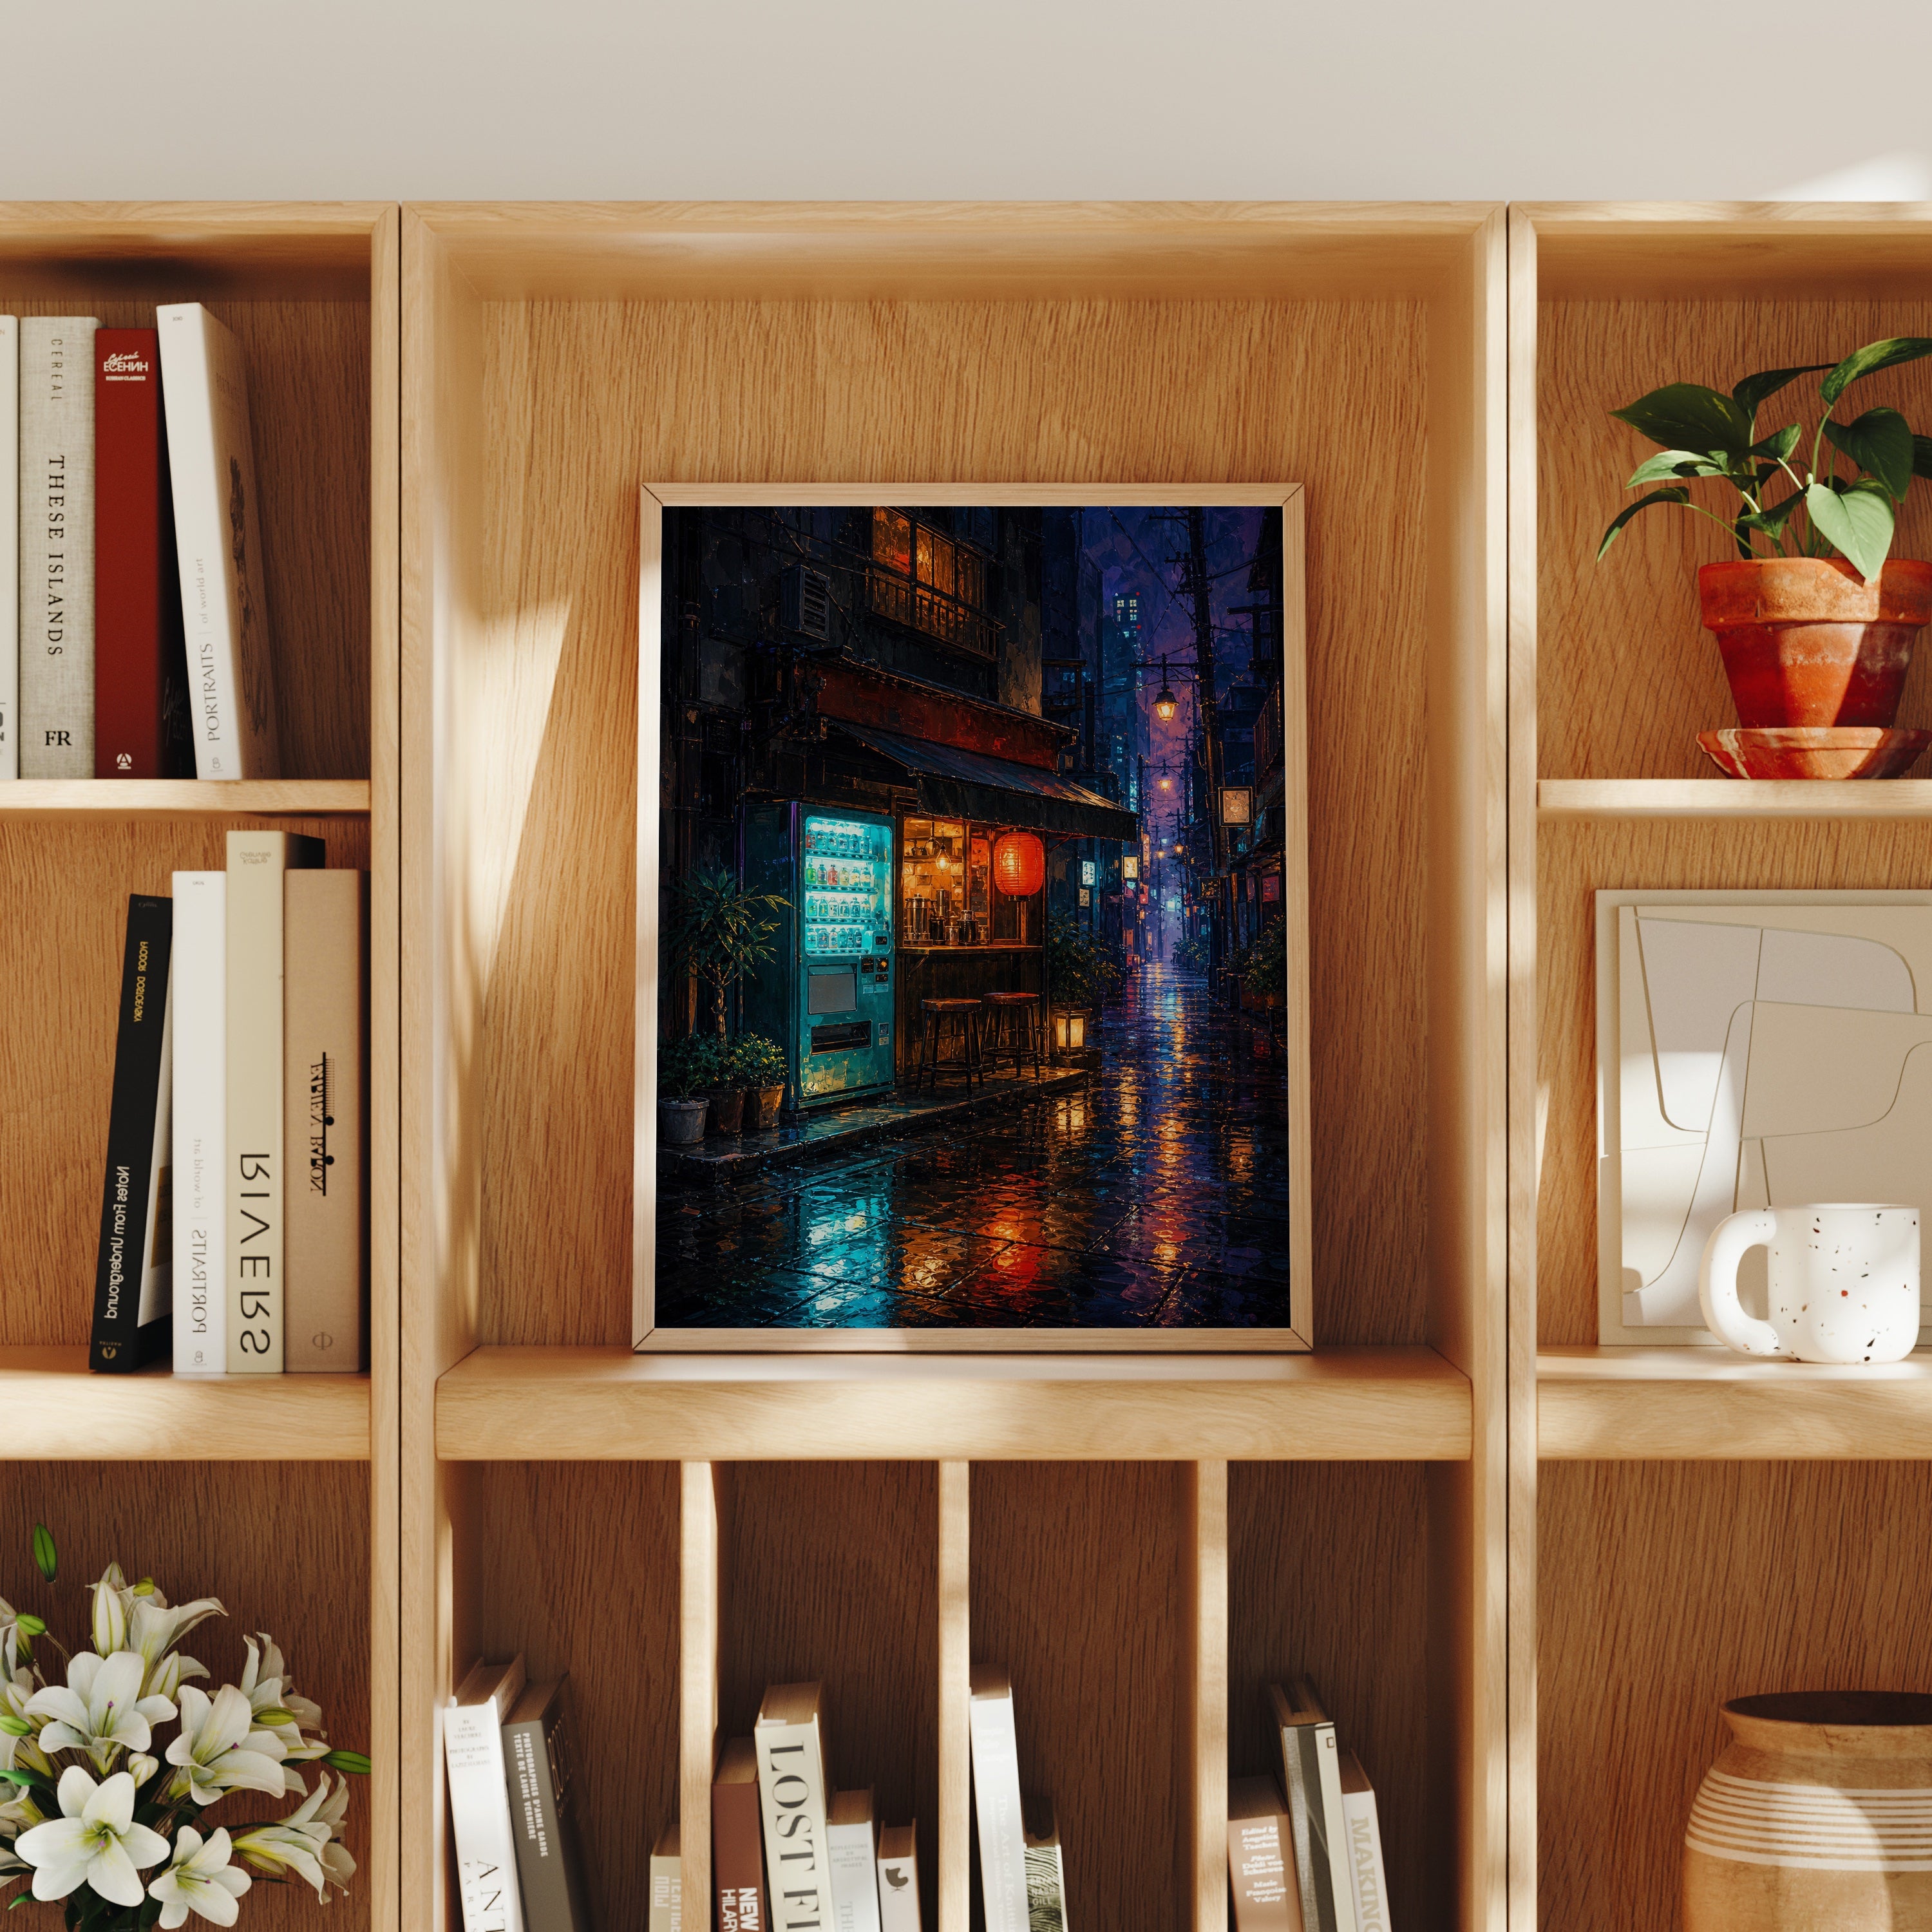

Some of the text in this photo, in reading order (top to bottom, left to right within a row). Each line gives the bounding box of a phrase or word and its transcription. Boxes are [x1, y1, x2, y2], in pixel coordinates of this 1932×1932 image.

[51, 339, 62, 401] CEREAL
[103, 361, 149, 372] ЕСЕНИН
[47, 455, 64, 655] THESE ISLANDS
[196, 558, 220, 741] PORTRAITS of world art
[44, 730, 72, 746] FR
[513, 1734, 524, 1759] TEXTE
[517, 1760, 526, 1772] DE
[519, 1774, 530, 1799] LAURE
[522, 1732, 548, 1857] PHOTOGRAPHIES D'ANNE GARDE
[769, 1741, 815, 1871] LOST
[998, 1793, 1010, 1827] The
[1000, 1830, 1011, 1860] Art
[1003, 1862, 1014, 1880] of
[739, 1887, 759, 1931] NEW
[1032, 1896, 1052, 1906] GILL
